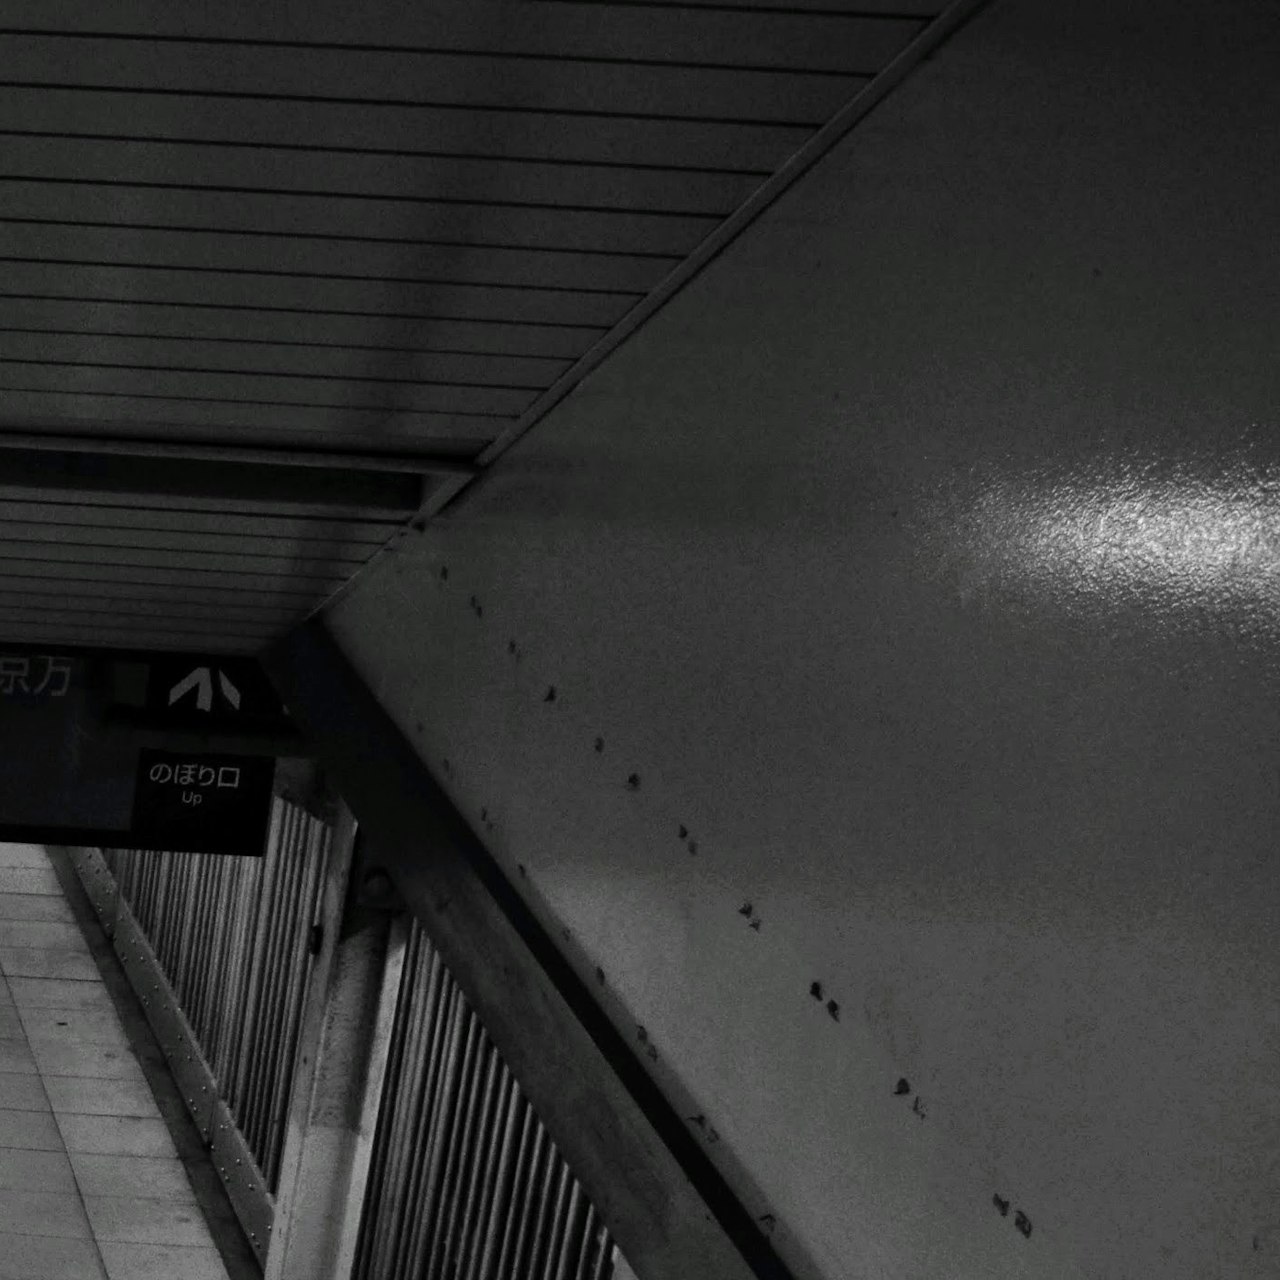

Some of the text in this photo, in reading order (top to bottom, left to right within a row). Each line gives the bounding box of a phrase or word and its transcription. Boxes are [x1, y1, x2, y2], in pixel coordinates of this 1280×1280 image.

[149, 763, 241, 789] のぼり口
[181, 791, 203, 807] Up
